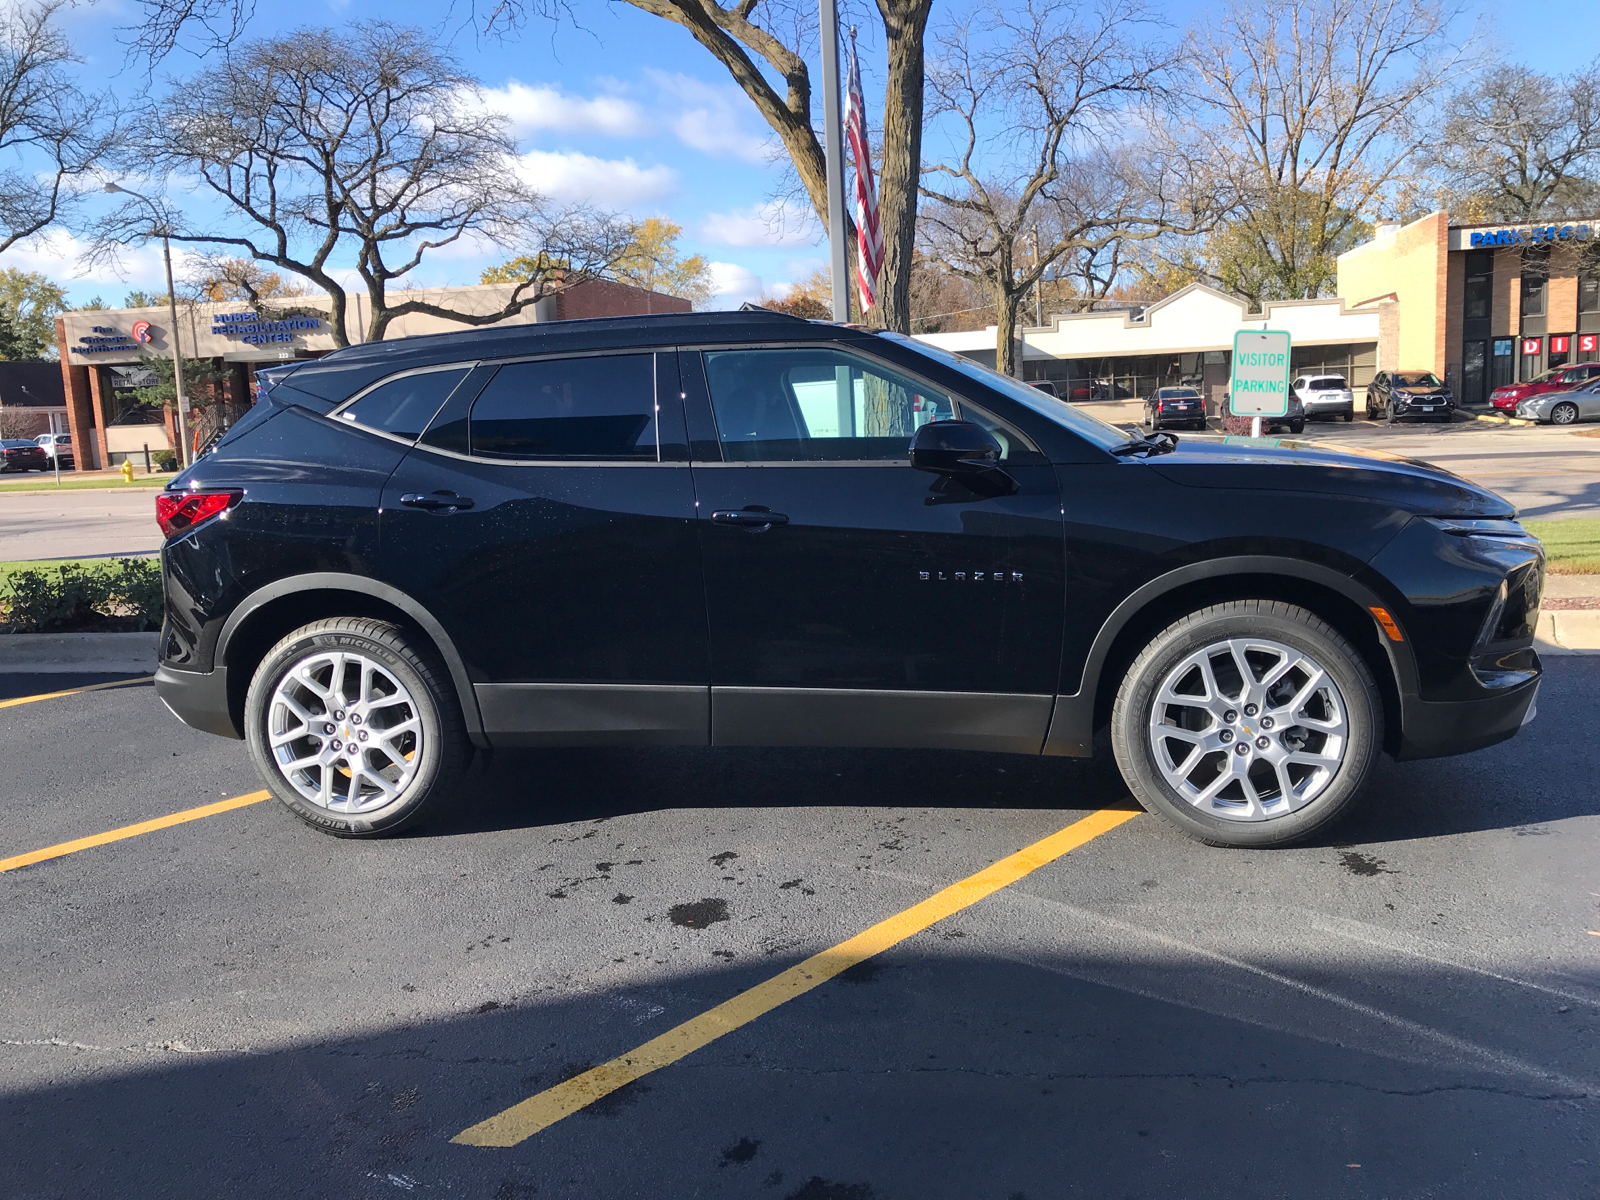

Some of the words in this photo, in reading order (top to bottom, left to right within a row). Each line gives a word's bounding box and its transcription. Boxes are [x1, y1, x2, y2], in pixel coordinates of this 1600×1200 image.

[1470, 228, 1526, 246] PARK
[213, 311, 258, 323] HUBER
[211, 319, 319, 335] REHABILITATION
[241, 333, 292, 344] CENTER
[1239, 353, 1285, 366] VISITOR
[1235, 379, 1285, 393] PARKING
[919, 571, 1023, 581] BLAZER
[340, 636, 396, 662] MICHELIN
[293, 803, 347, 829] MICHELIN
